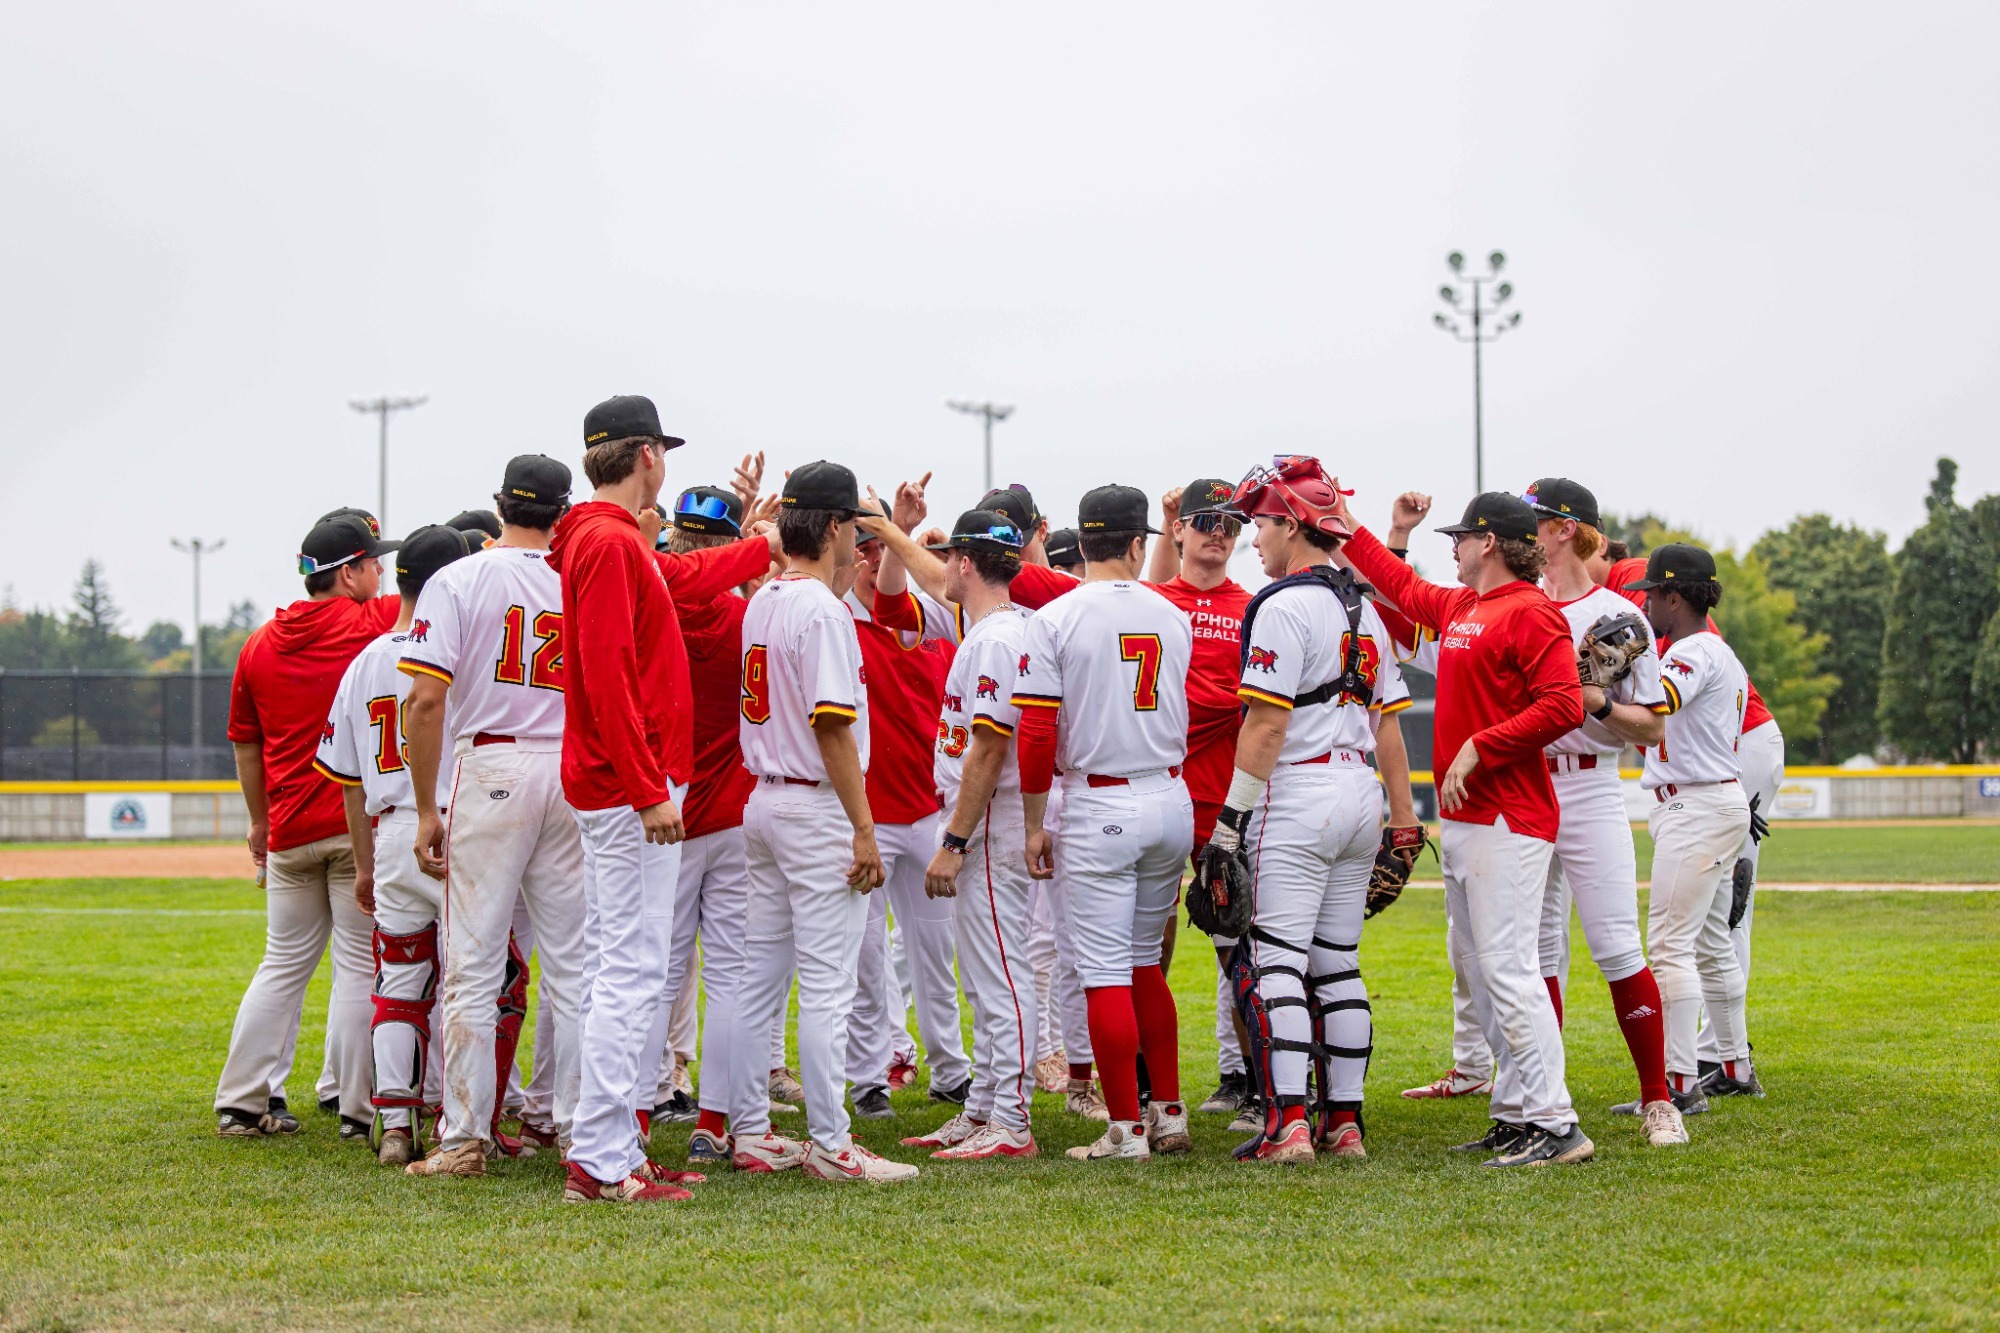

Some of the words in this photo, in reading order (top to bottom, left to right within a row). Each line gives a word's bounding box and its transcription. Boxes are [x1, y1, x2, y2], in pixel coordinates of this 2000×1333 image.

[587, 431, 609, 442] GUELPH
[512, 488, 536, 499] GUELPH
[682, 521, 705, 530] GUELPH
[1193, 626, 1240, 643] EBALL
[494, 604, 565, 694] 12
[1118, 632, 1163, 712] 7
[741, 643, 771, 726] 9
